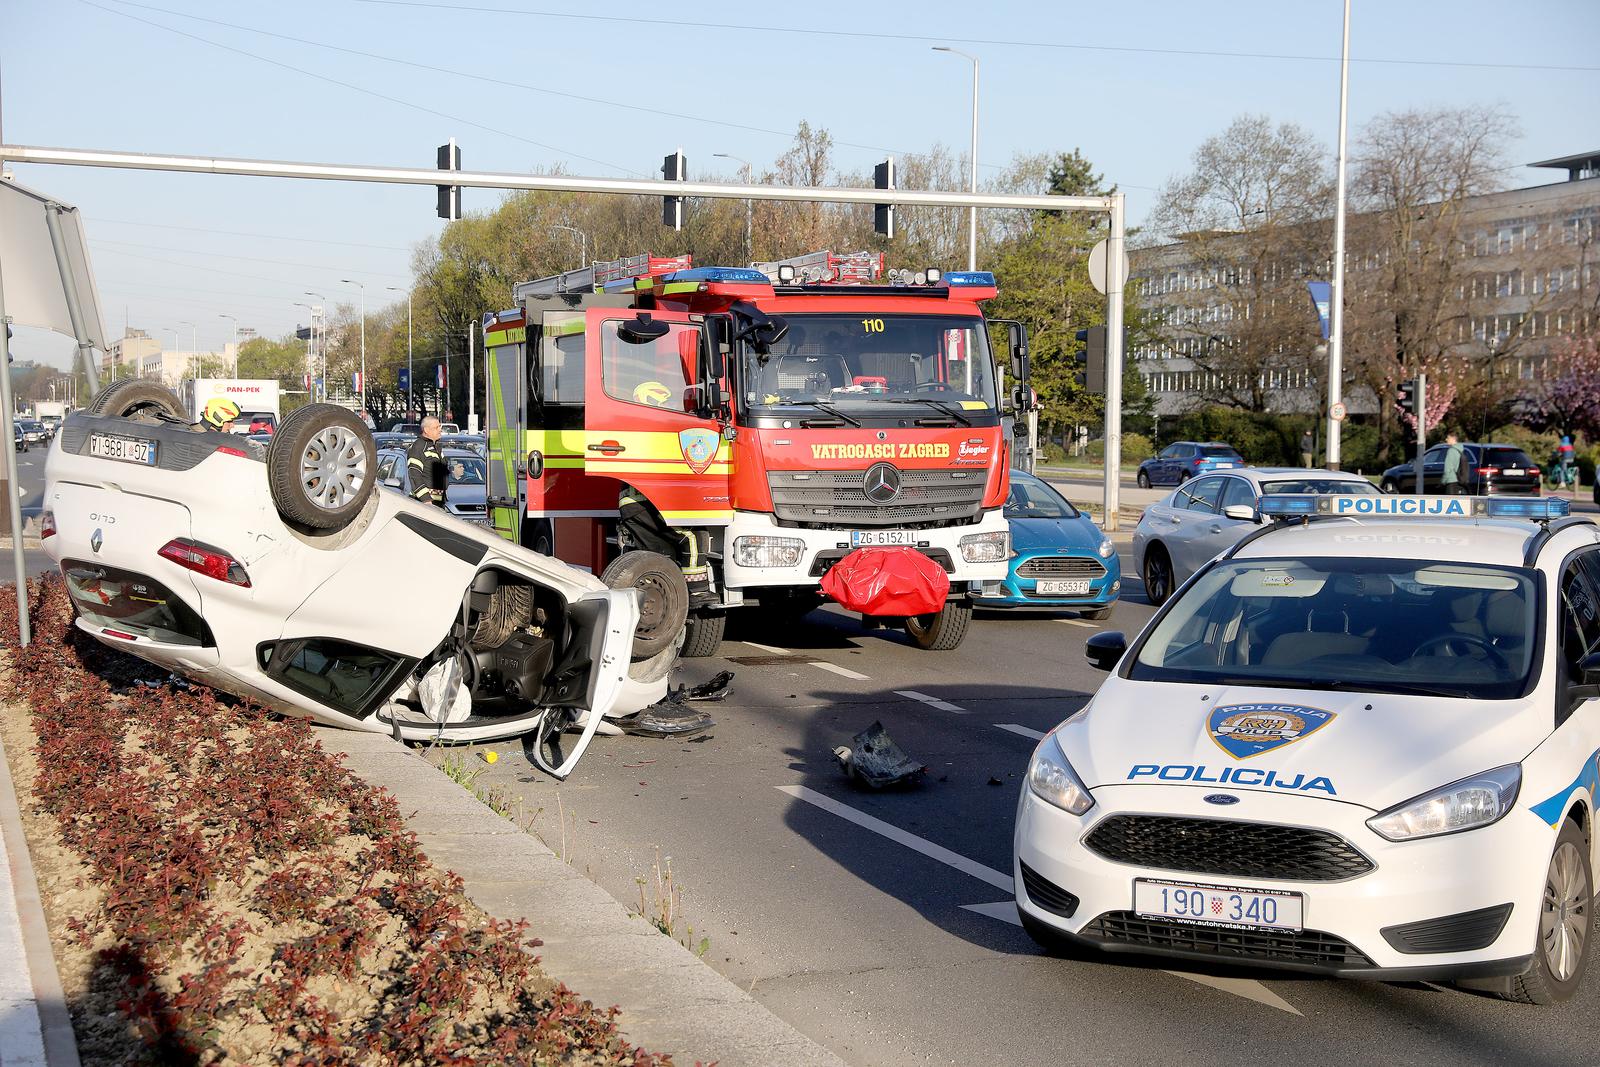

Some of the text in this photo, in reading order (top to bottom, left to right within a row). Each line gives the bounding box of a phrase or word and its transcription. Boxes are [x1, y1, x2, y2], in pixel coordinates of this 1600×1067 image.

[861, 318, 885, 333] 110
[134, 443, 147, 461] ZG
[811, 443, 950, 459] VATROGASCI ZAGREB
[1338, 498, 1465, 515] POLICIJA
[860, 532, 873, 544] ZG
[1042, 582, 1053, 591] ZG
[1221, 704, 1328, 719] POLICIJA
[1126, 764, 1337, 796] POLICIJA
[1161, 888, 1277, 924] 190 340
[1177, 917, 1256, 931] www.autohrvatska.hr
